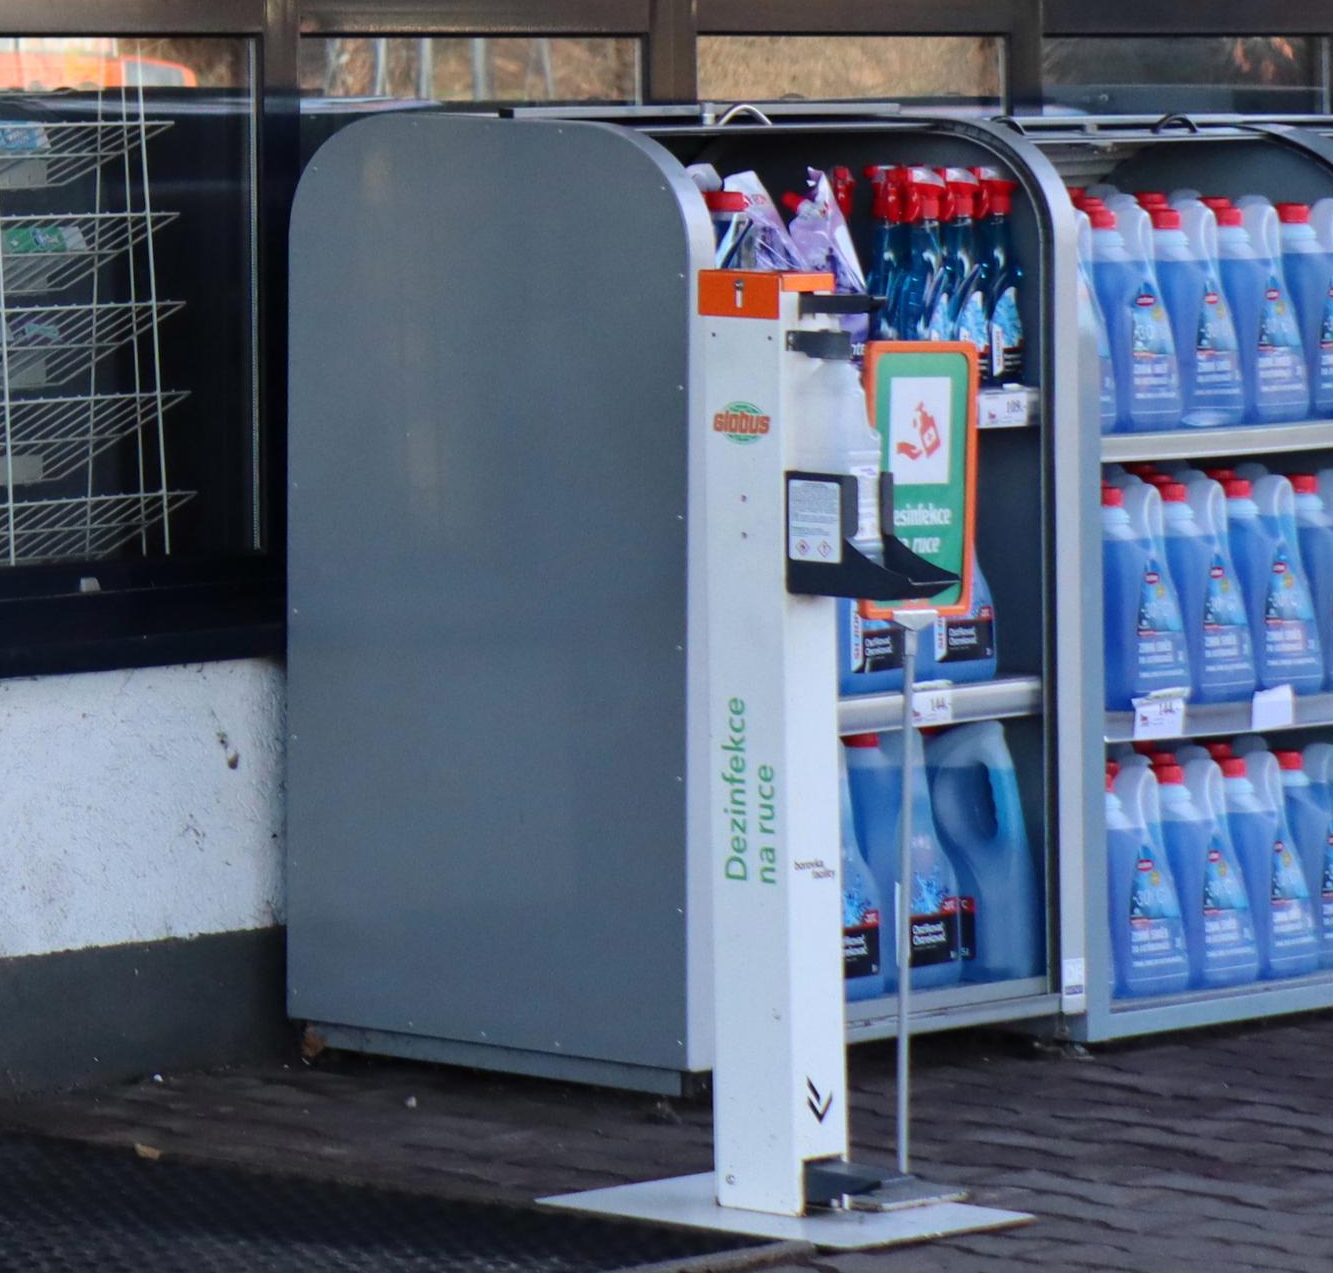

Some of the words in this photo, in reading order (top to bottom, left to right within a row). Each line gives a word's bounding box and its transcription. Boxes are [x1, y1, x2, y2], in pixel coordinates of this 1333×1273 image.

[721, 697, 749, 881] Dezinfekce
[758, 764, 775, 834] ruce
[759, 845, 777, 884] na
